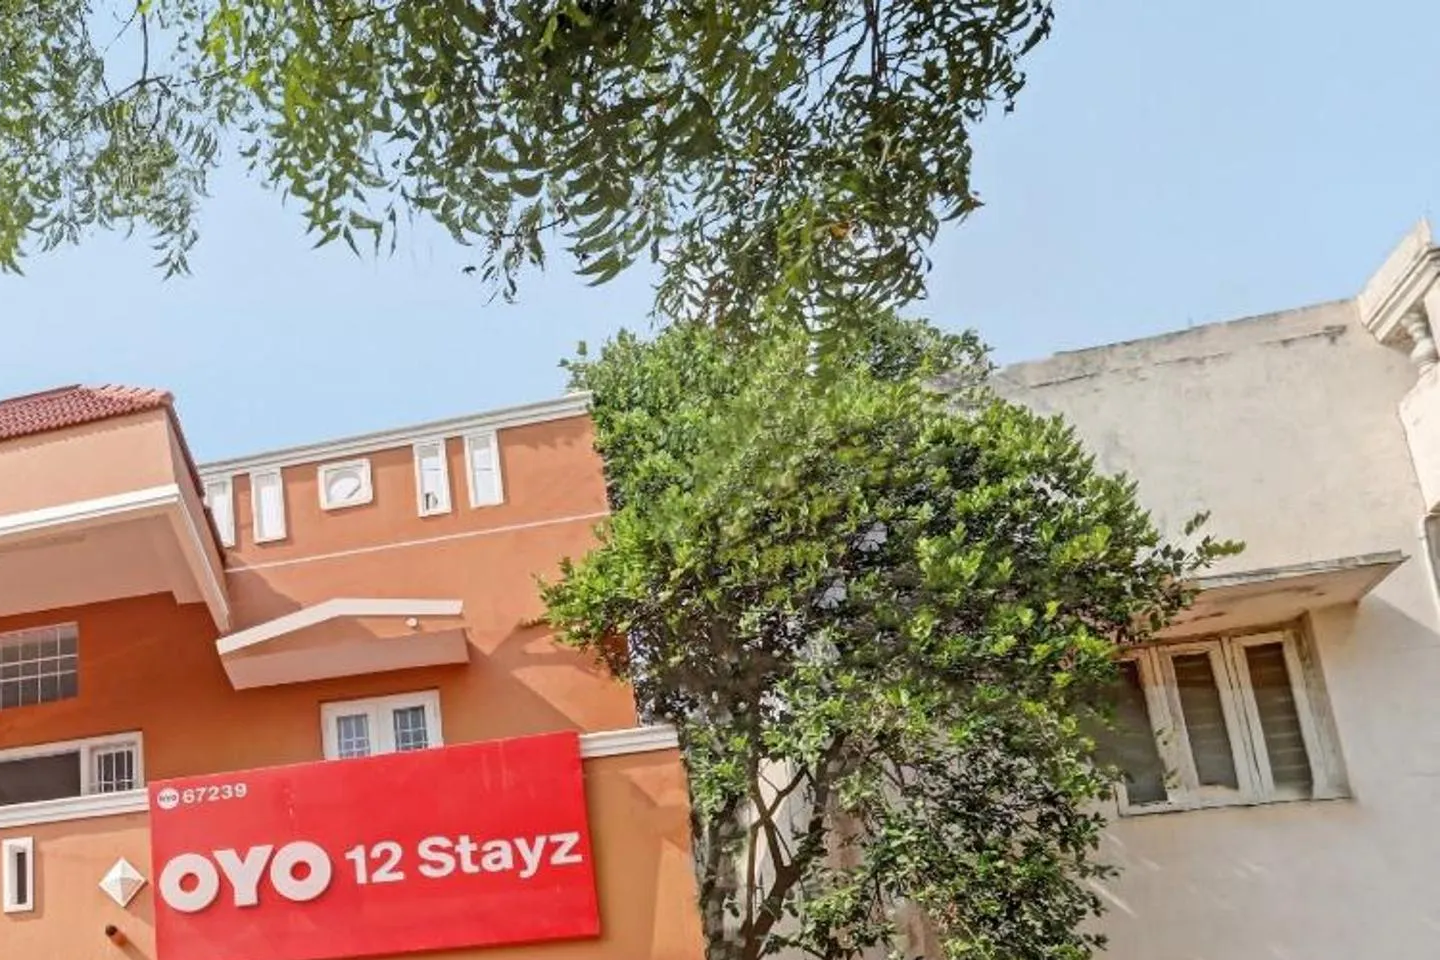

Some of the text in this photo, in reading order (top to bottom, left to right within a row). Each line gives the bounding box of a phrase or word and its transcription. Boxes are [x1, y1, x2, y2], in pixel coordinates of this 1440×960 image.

[182, 783, 248, 804] 67239
[159, 831, 583, 914] OYO 12 Stayz
